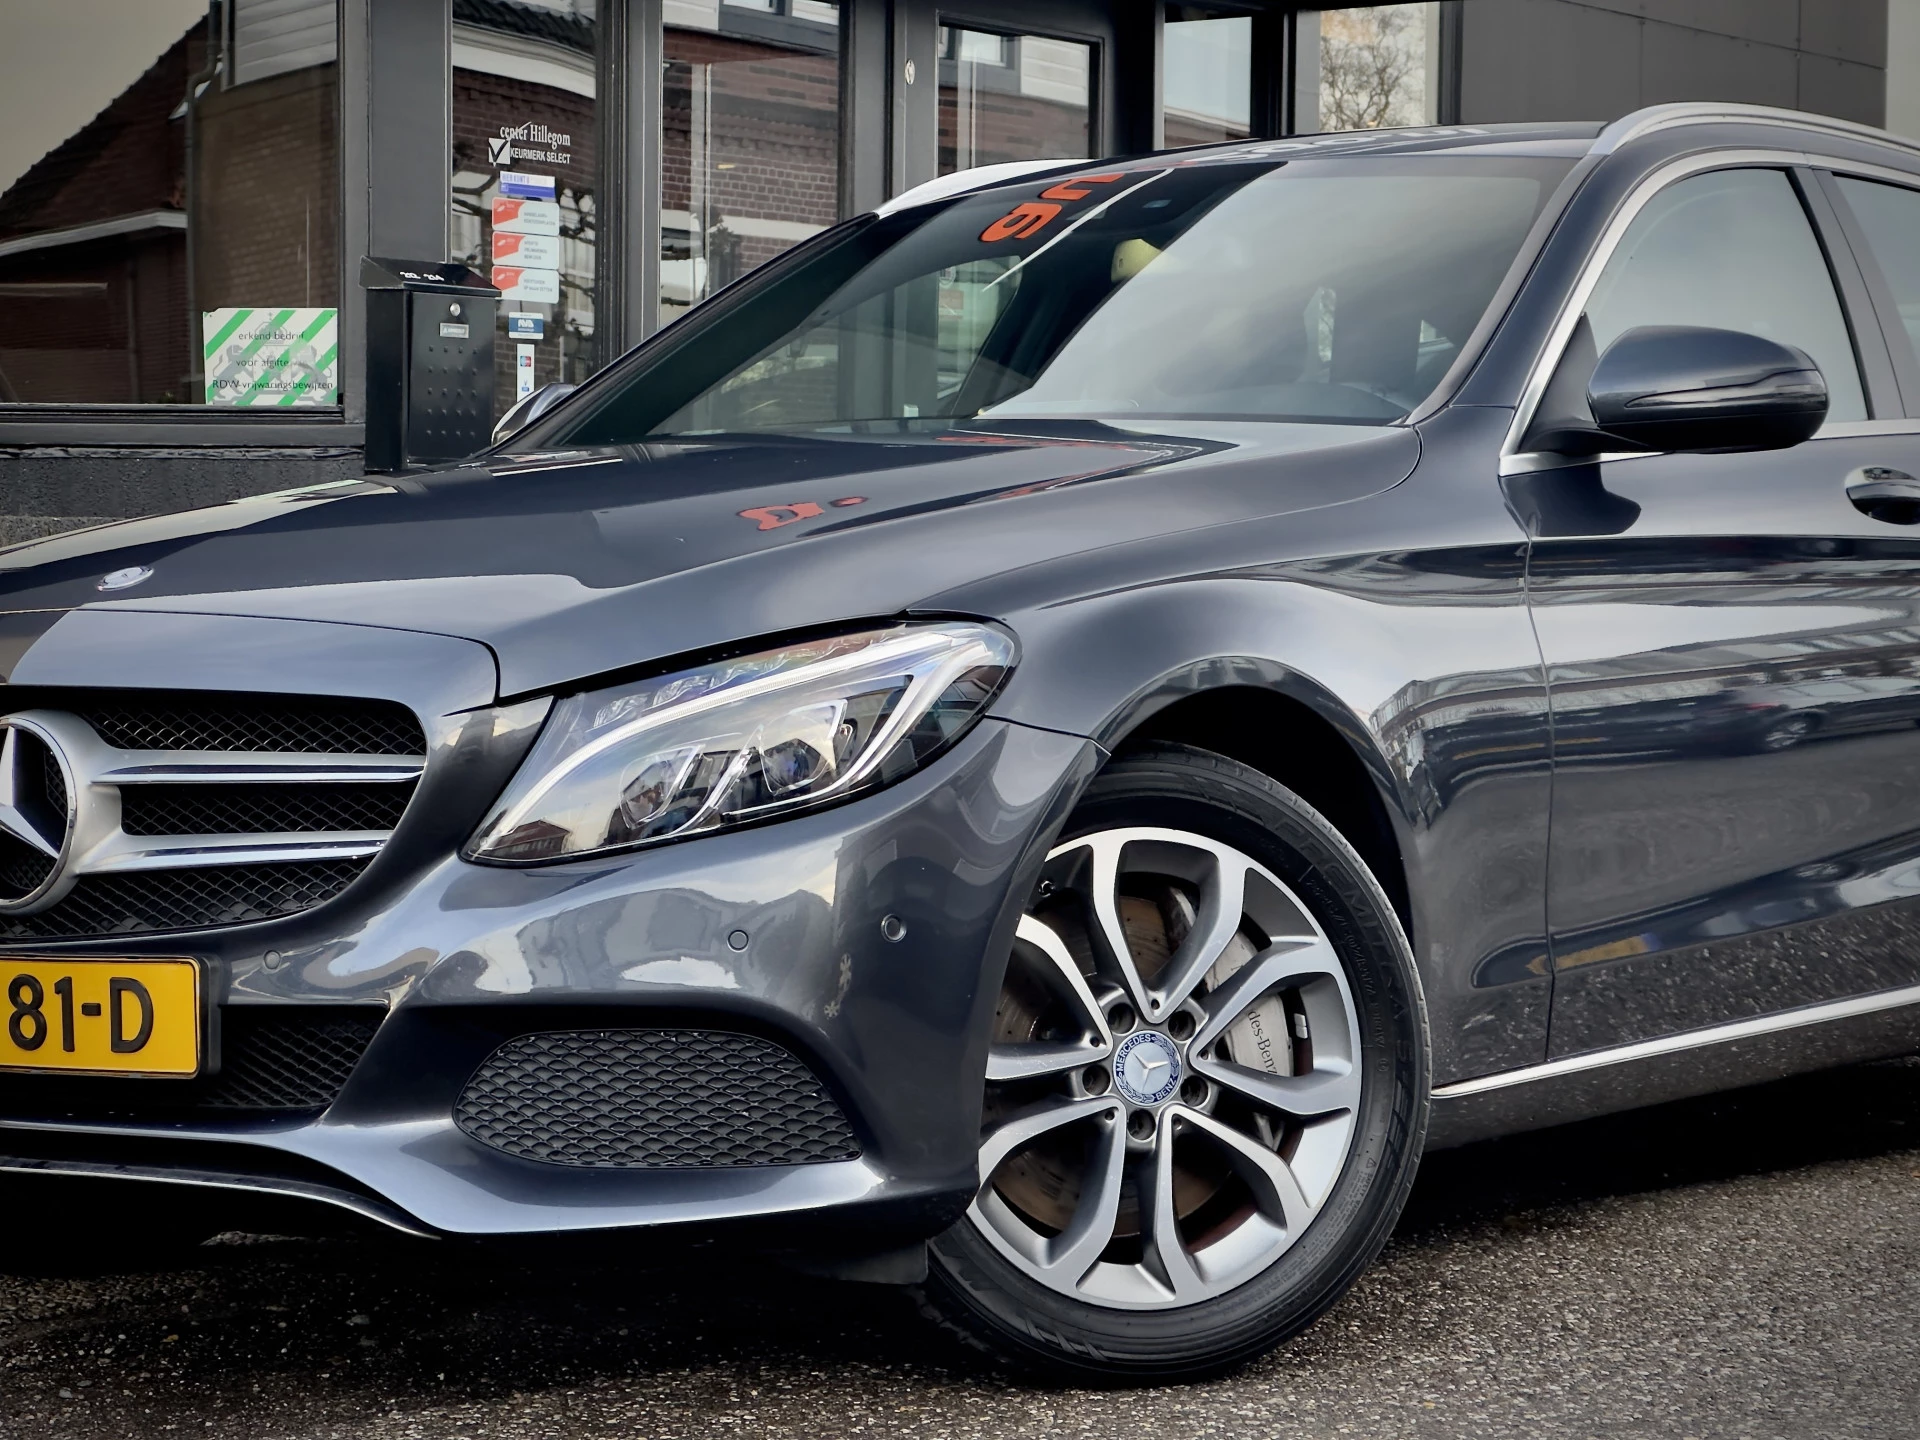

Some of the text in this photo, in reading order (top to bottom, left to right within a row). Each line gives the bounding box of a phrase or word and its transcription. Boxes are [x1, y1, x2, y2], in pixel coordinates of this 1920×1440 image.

[530, 124, 571, 150] Hillegom
[510, 147, 571, 164] KEURMERK SELECT
[238, 332, 271, 340] erkend
[235, 359, 257, 367] voor
[261, 357, 289, 369] afgifte
[8, 973, 154, 1054] 81-D
[1116, 1033, 1152, 1072] MERCEDES
[1247, 1011, 1278, 1074] des-Benz
[1155, 1078, 1177, 1101] BENZ
